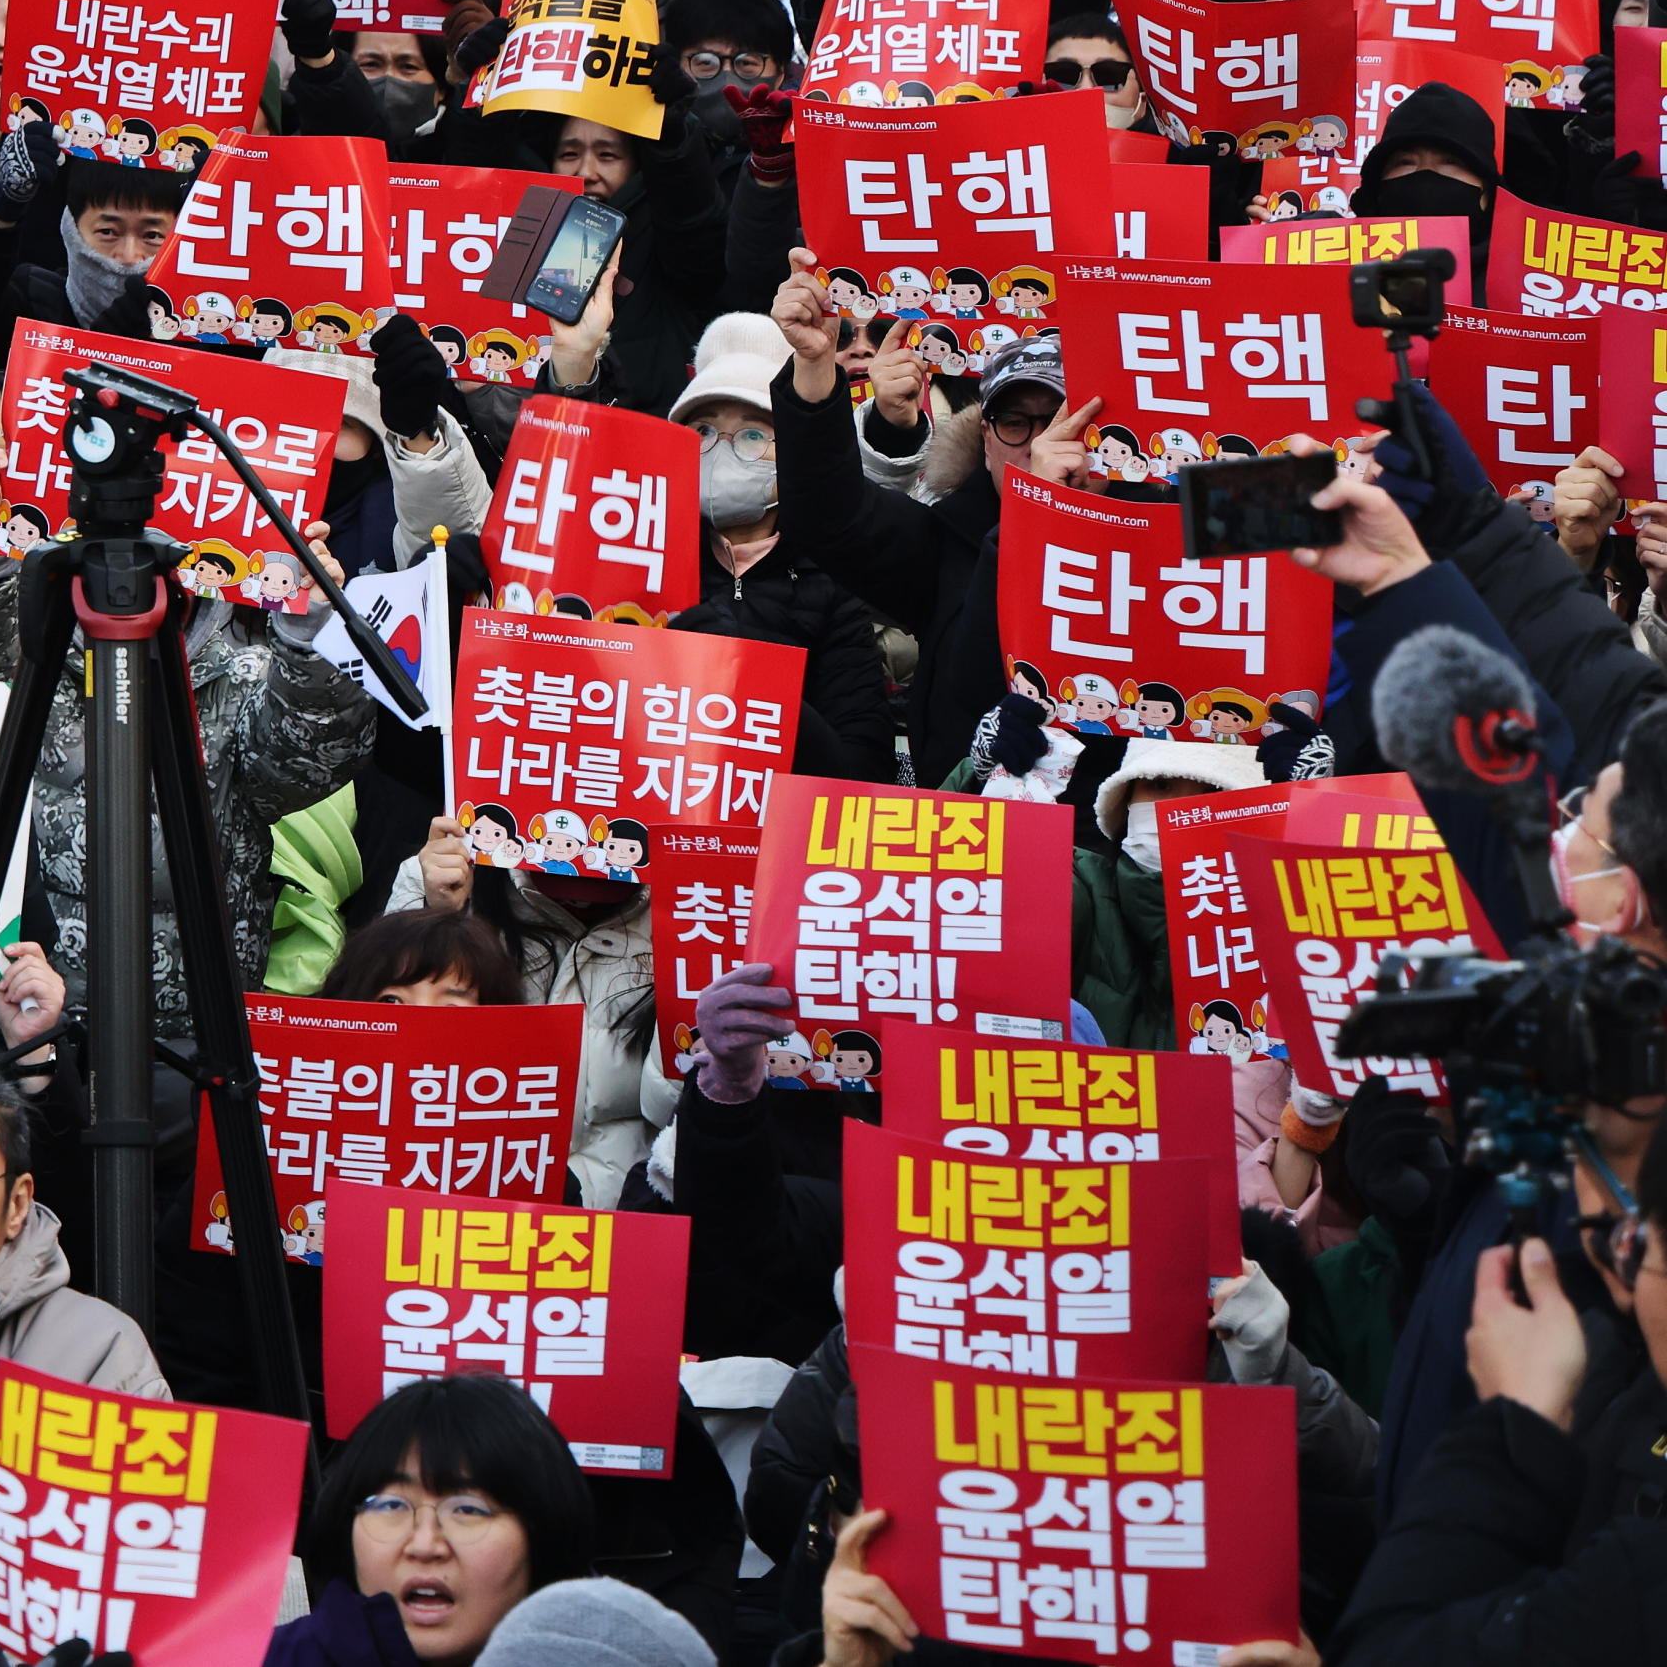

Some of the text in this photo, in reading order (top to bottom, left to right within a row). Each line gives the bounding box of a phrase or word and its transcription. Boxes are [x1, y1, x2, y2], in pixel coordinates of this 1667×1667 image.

[25, 45, 246, 115] 윤석열 체포
[1137, 11, 1298, 110] 탄핵
[845, 143, 1055, 253] 탄핵
[499, 459, 668, 593] 탄핵
[475, 618, 633, 653] 나눔문화 www.nanum.com
[1041, 542, 1266, 676] 탄핵
[115, 646, 132, 726] sachtler
[473, 667, 784, 753] 촛불의 힘으로
[466, 736, 773, 827] 나라를 지키자
[806, 795, 1004, 874] 내란죄
[797, 870, 1003, 953] 윤석열
[289, 1014, 397, 1034] www.nanum.com
[795, 946, 957, 1025] 탄핵!
[410, 1063, 559, 1121] 힘으로
[401, 1136, 553, 1195] 지키자
[933, 1382, 1203, 1476] 내란죄
[936, 1471, 1206, 1567] 윤석열
[940, 1555, 1152, 1657] 탄핵!
